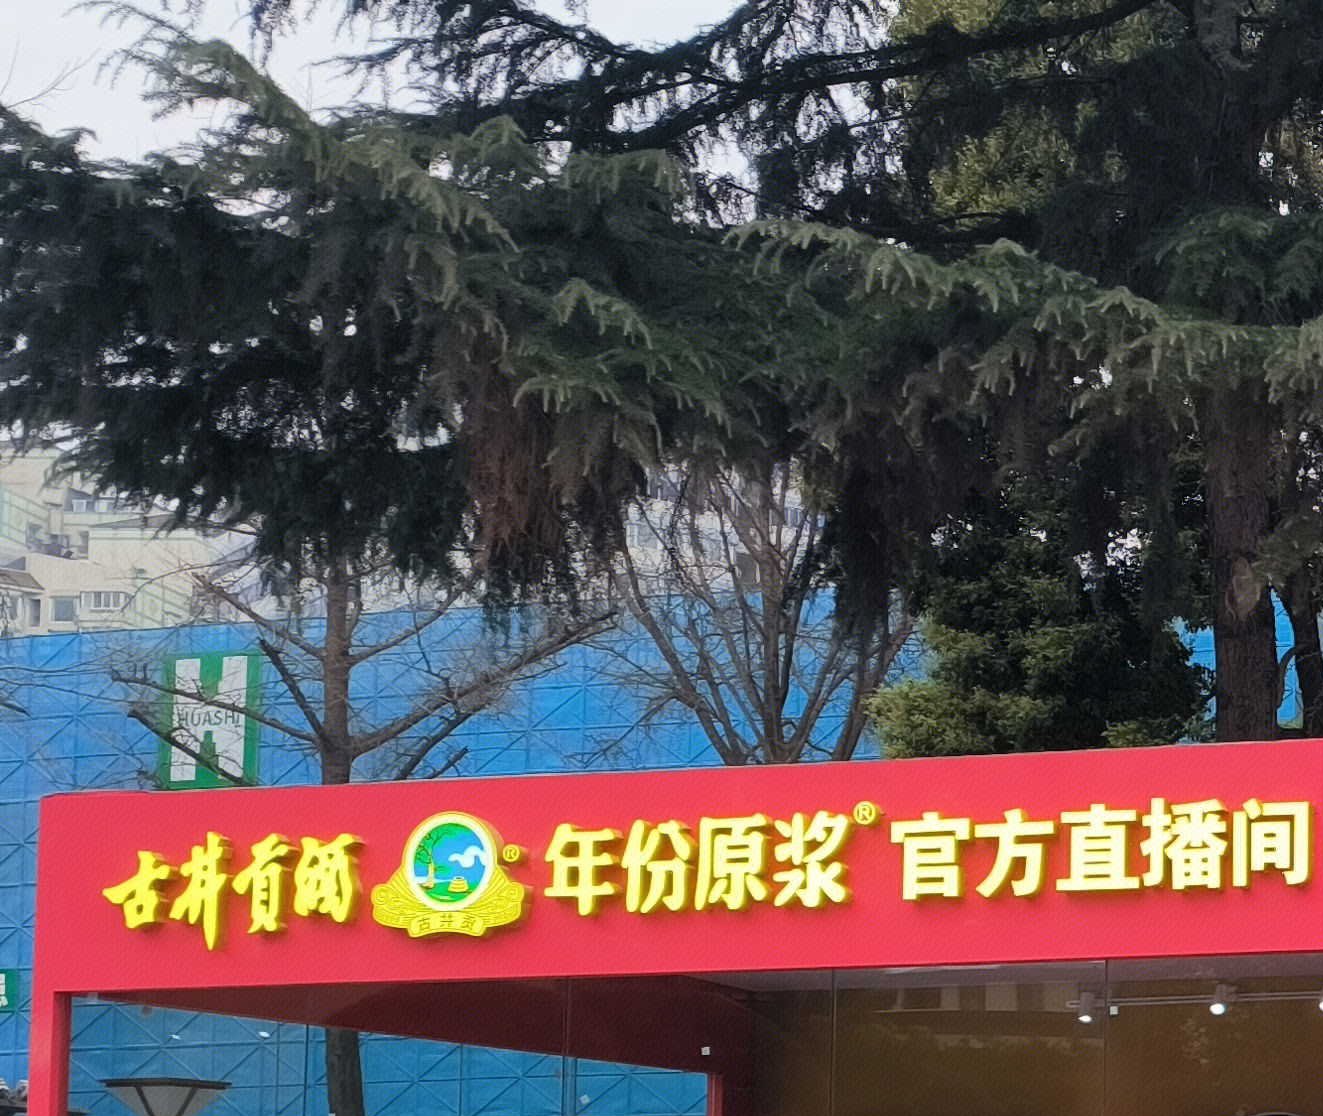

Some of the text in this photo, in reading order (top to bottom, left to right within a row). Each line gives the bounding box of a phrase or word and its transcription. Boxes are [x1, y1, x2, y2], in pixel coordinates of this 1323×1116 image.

[544, 811, 850, 916] 年份原浆
[890, 798, 1312, 901] 官方直播间
